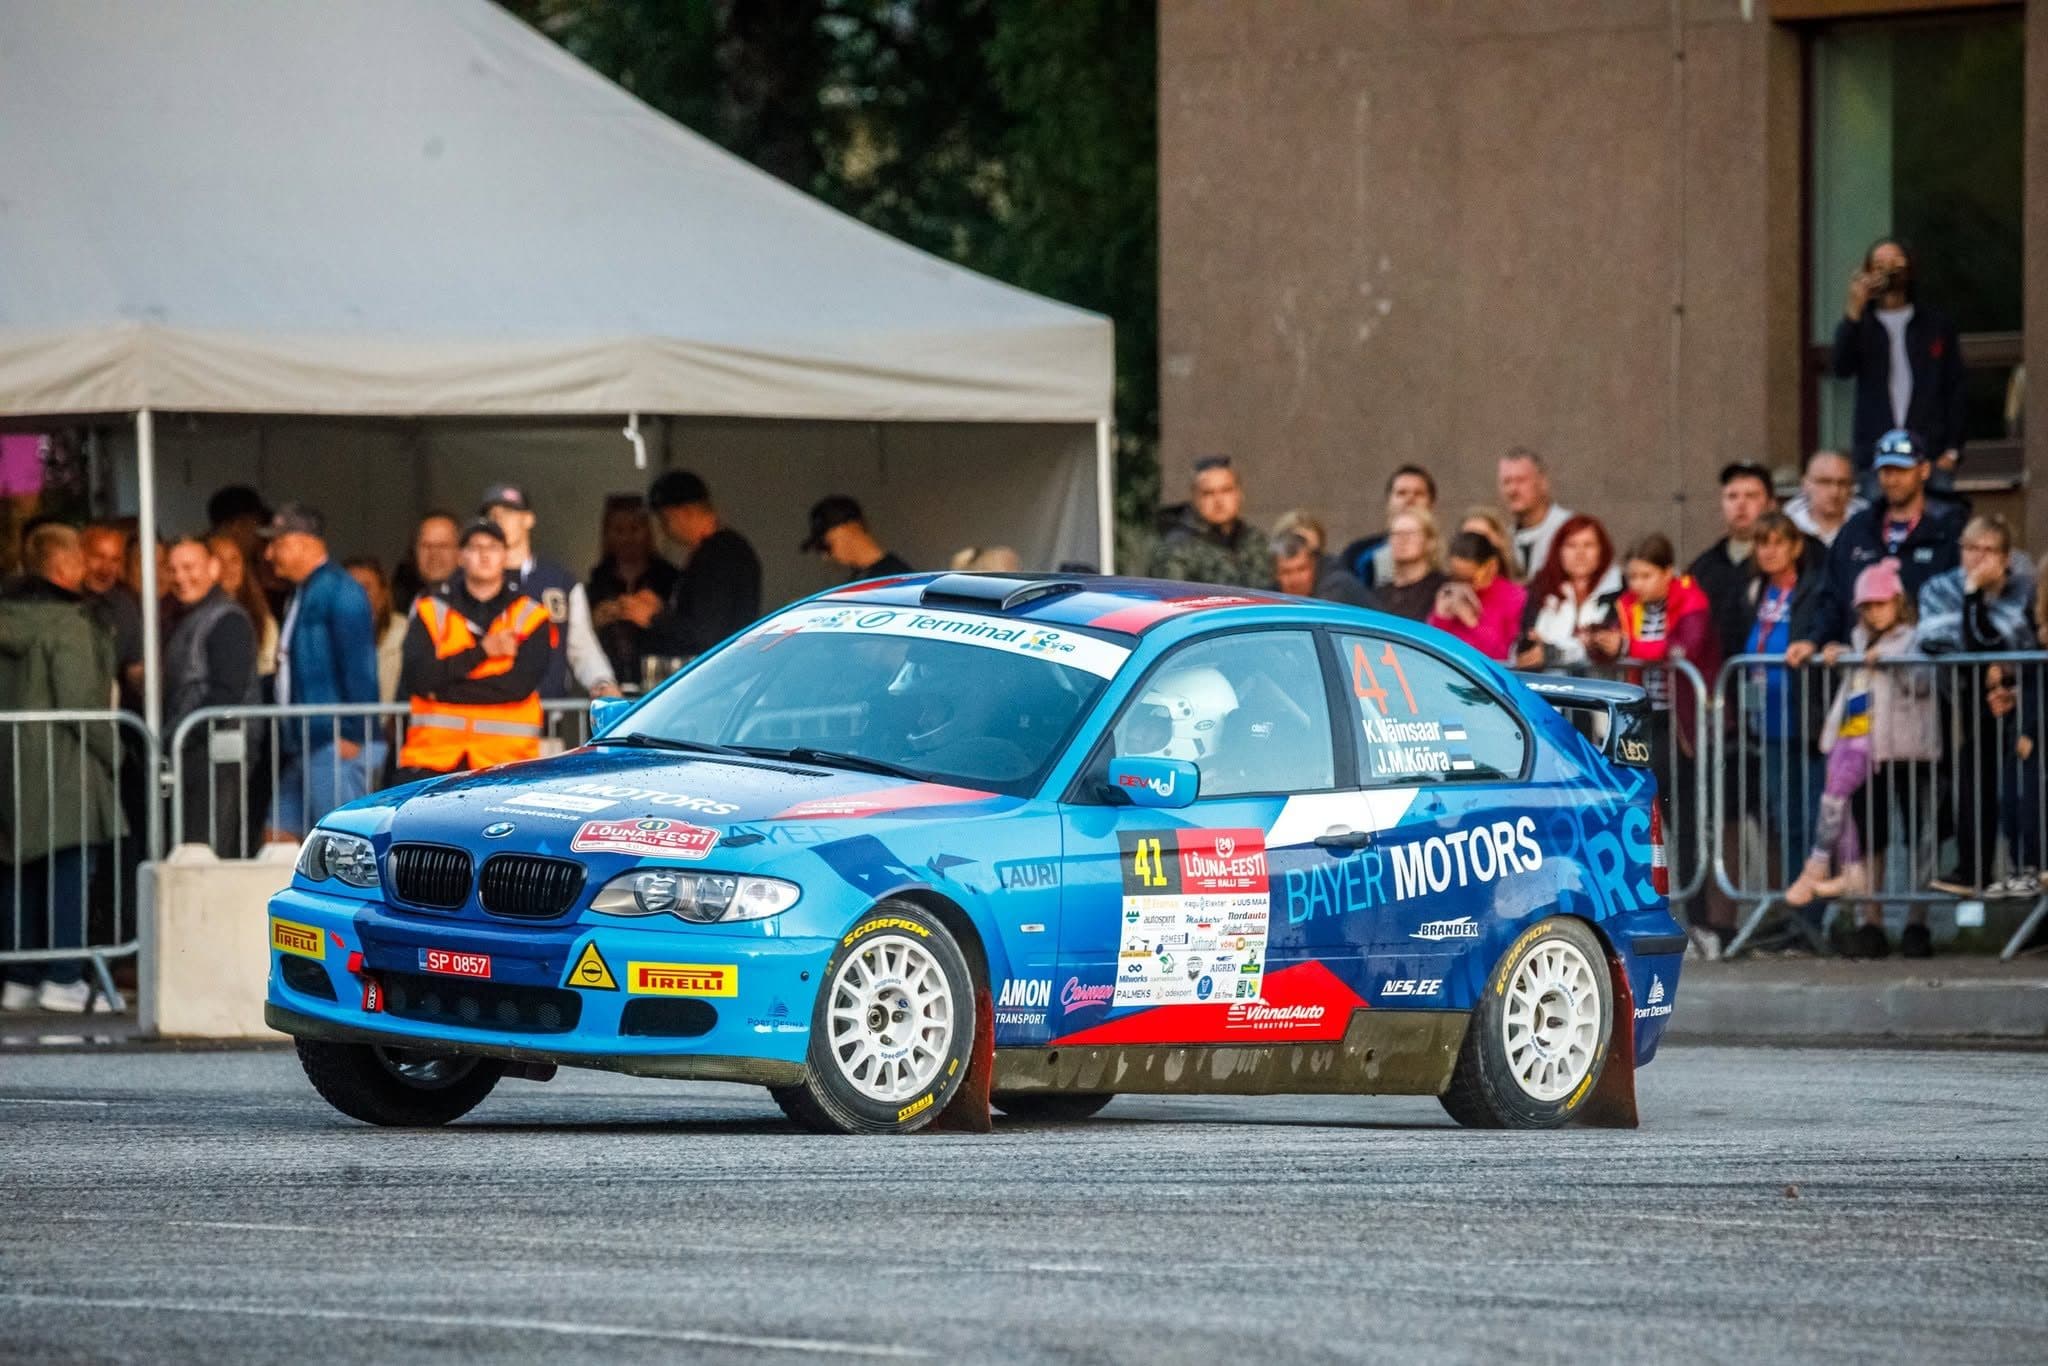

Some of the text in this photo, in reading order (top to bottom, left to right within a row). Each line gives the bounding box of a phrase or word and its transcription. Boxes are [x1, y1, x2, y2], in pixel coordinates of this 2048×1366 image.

[905, 614, 1024, 643] Terminal
[1353, 641, 1418, 715] 41
[563, 783, 740, 815] MOTORS
[587, 825, 708, 845] LÕUNA-EESTI
[641, 821, 665, 830] 41
[630, 836, 657, 844] RALLI
[1135, 838, 1168, 887] 41
[1184, 851, 1266, 878] LÕUNA-EESTI
[1286, 816, 1543, 925] BAYER MOTORS
[1217, 879, 1236, 887] RALLI
[275, 922, 318, 953] PIRELLI
[843, 917, 930, 948] SCORPION
[1422, 923, 1479, 938] BRANDEX
[428, 952, 487, 974] SP 0857
[1210, 964, 1236, 973] AIGREN
[1496, 923, 1552, 995] SCORPION
[638, 967, 724, 991] PIRELLI
[1381, 979, 1442, 996] NFS.EE
[998, 978, 1052, 1007] AMON
[1116, 989, 1151, 999] PALMEKS
[995, 1013, 1046, 1026] TRANSPORT
[1246, 1005, 1325, 1020] VinnalAuto
[1633, 1007, 1650, 1019] PORT
